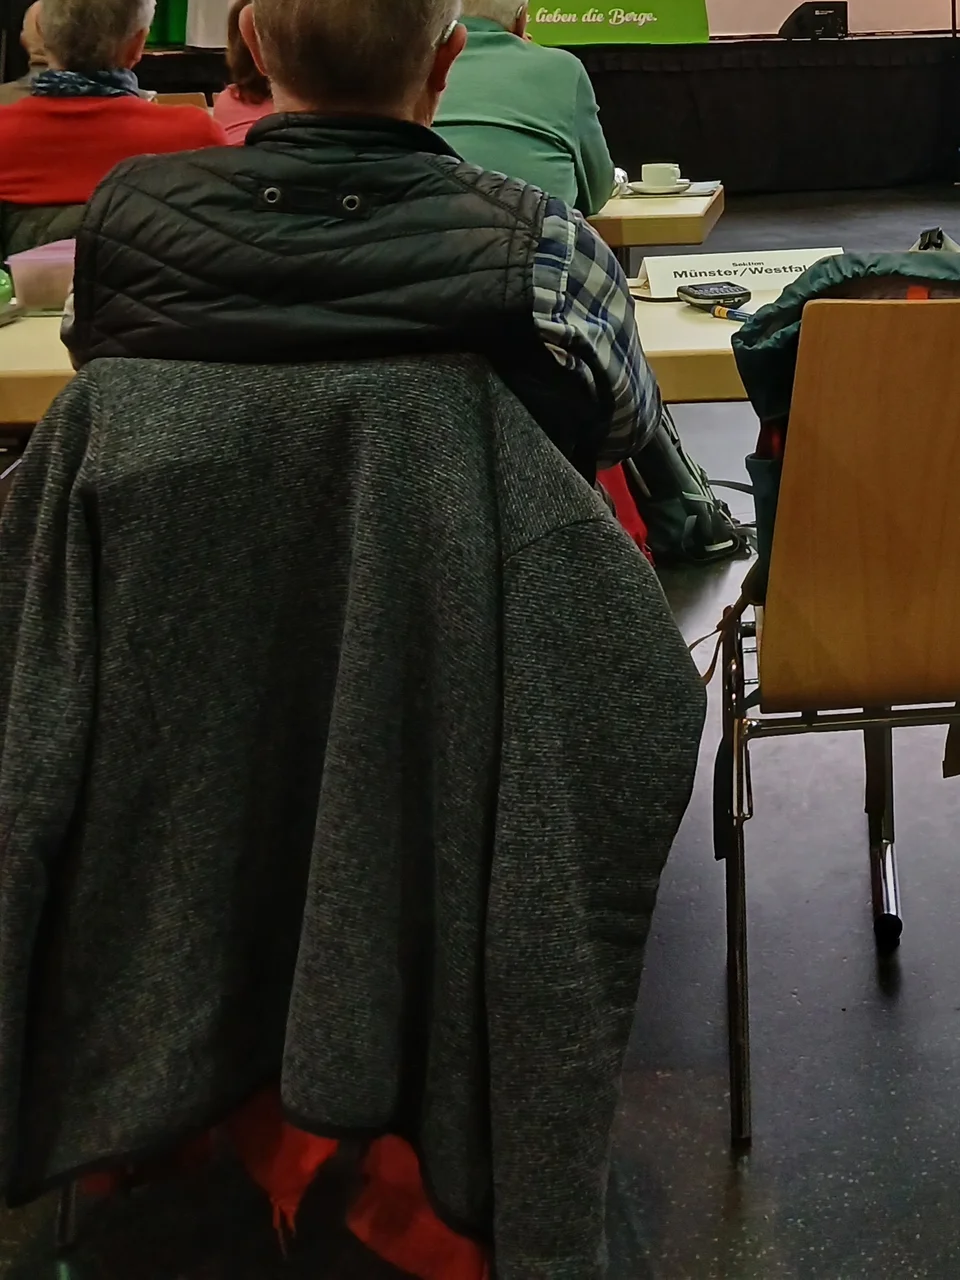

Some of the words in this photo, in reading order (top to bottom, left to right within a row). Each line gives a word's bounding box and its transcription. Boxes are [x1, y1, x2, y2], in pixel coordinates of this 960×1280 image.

[536, 7, 578, 24] lieben
[582, 8, 604, 24] die
[608, 8, 658, 26] Berge.
[673, 264, 807, 279] Münster/Westfal
